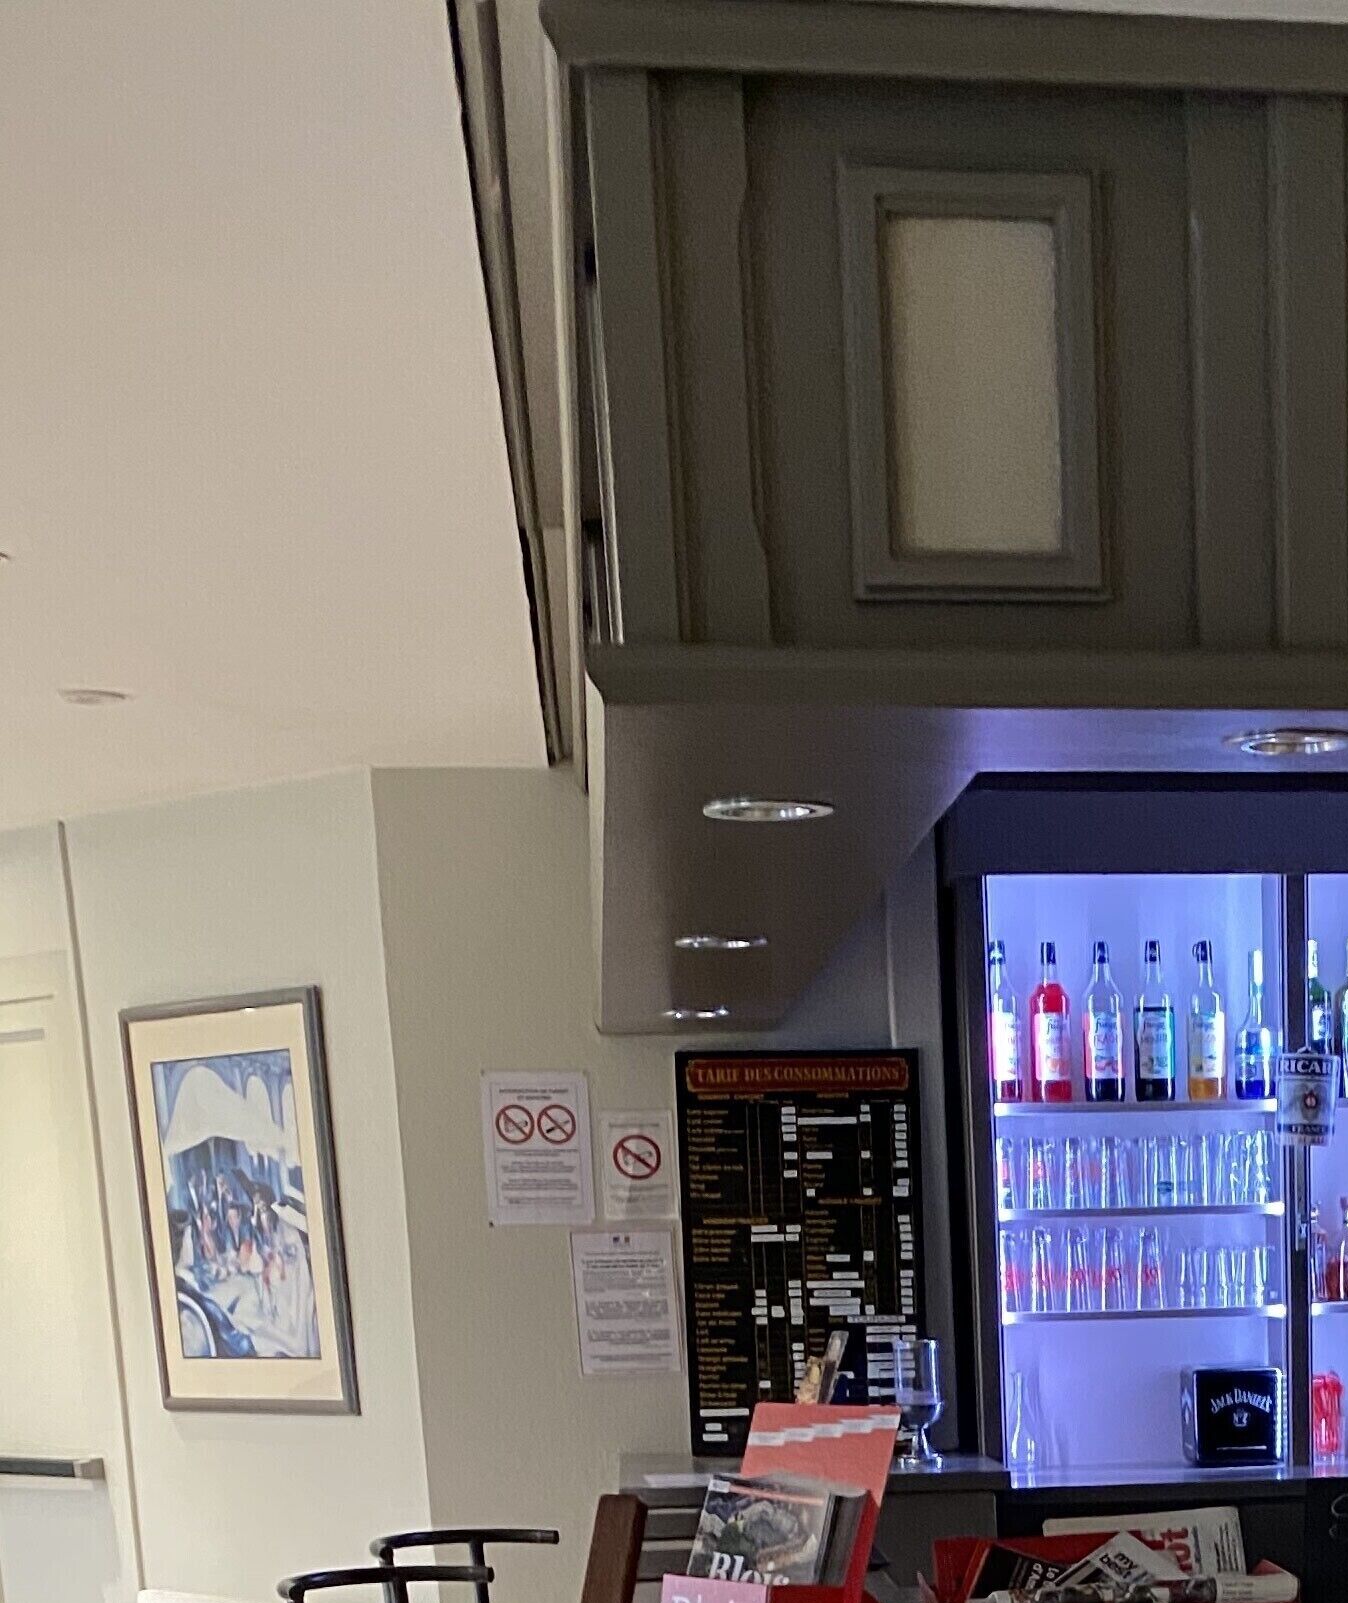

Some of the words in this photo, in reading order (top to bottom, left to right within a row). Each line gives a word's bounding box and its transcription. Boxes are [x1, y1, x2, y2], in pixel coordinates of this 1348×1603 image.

[697, 1069, 739, 1084] TARIF
[743, 1067, 772, 1082] DES
[774, 1066, 900, 1083] CONSOMMATIONS
